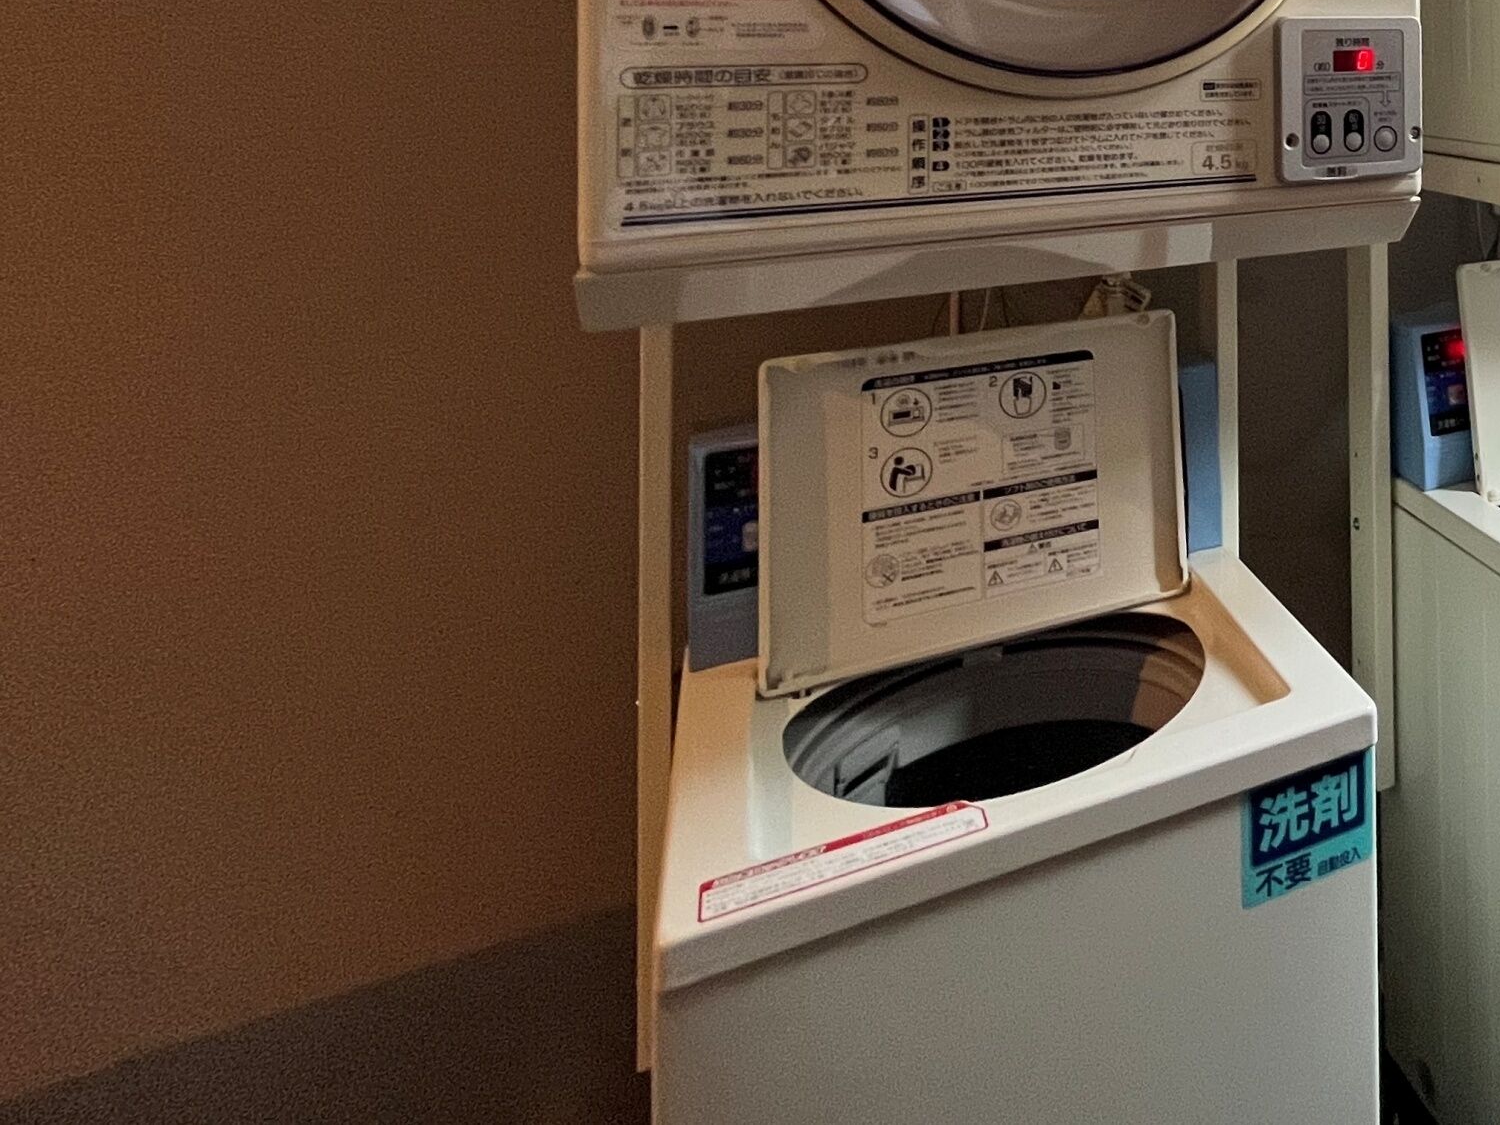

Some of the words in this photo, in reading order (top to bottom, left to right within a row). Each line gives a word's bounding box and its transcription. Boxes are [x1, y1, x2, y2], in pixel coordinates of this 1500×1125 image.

[1202, 154, 1232, 171] 4.5
[989, 376, 998, 388] 2
[868, 446, 878, 460] 3
[1259, 764, 1358, 853] 洗剤
[1256, 852, 1312, 897] 不要
[1317, 846, 1362, 874] 自動投入
